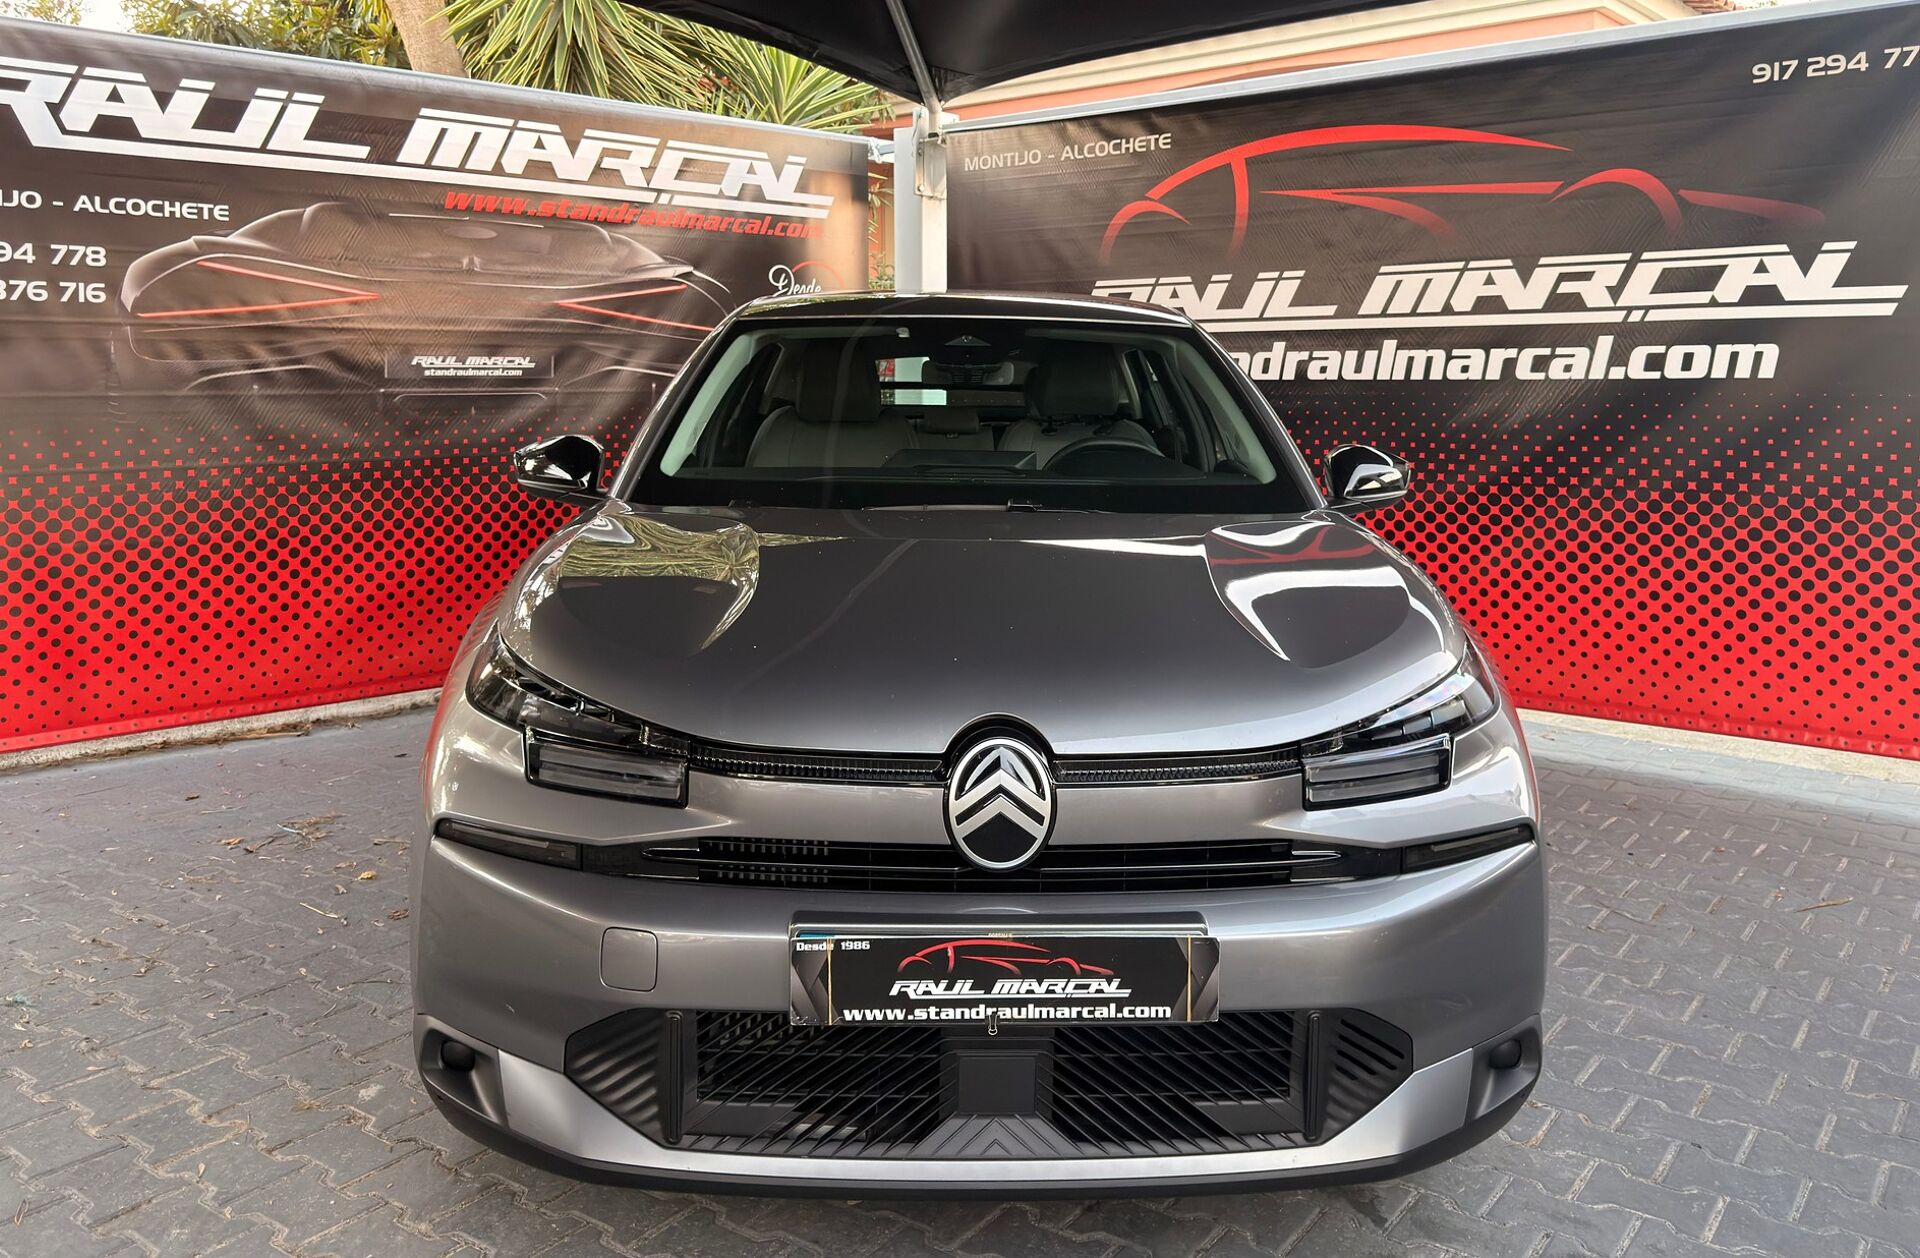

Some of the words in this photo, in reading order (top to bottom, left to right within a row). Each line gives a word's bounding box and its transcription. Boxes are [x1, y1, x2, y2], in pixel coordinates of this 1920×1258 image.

[1752, 59, 1799, 84] 917
[1806, 51, 1869, 77] 294
[0, 56, 371, 166] RAUL
[964, 149, 1042, 172] MONTIJO
[1061, 132, 1172, 162] ALCOCHETE
[73, 194, 230, 222] ALCOCHETE
[444, 191, 822, 239] www.standraulmarcal.com
[50, 244, 107, 267] 778
[59, 281, 107, 303] 716
[411, 356, 463, 367] RAUL
[424, 368, 523, 377] standraulmarcal.com
[840, 941, 871, 951] 1986
[889, 980, 985, 999] RAUL
[843, 1003, 1172, 1021] www.standraulmarcal.com
